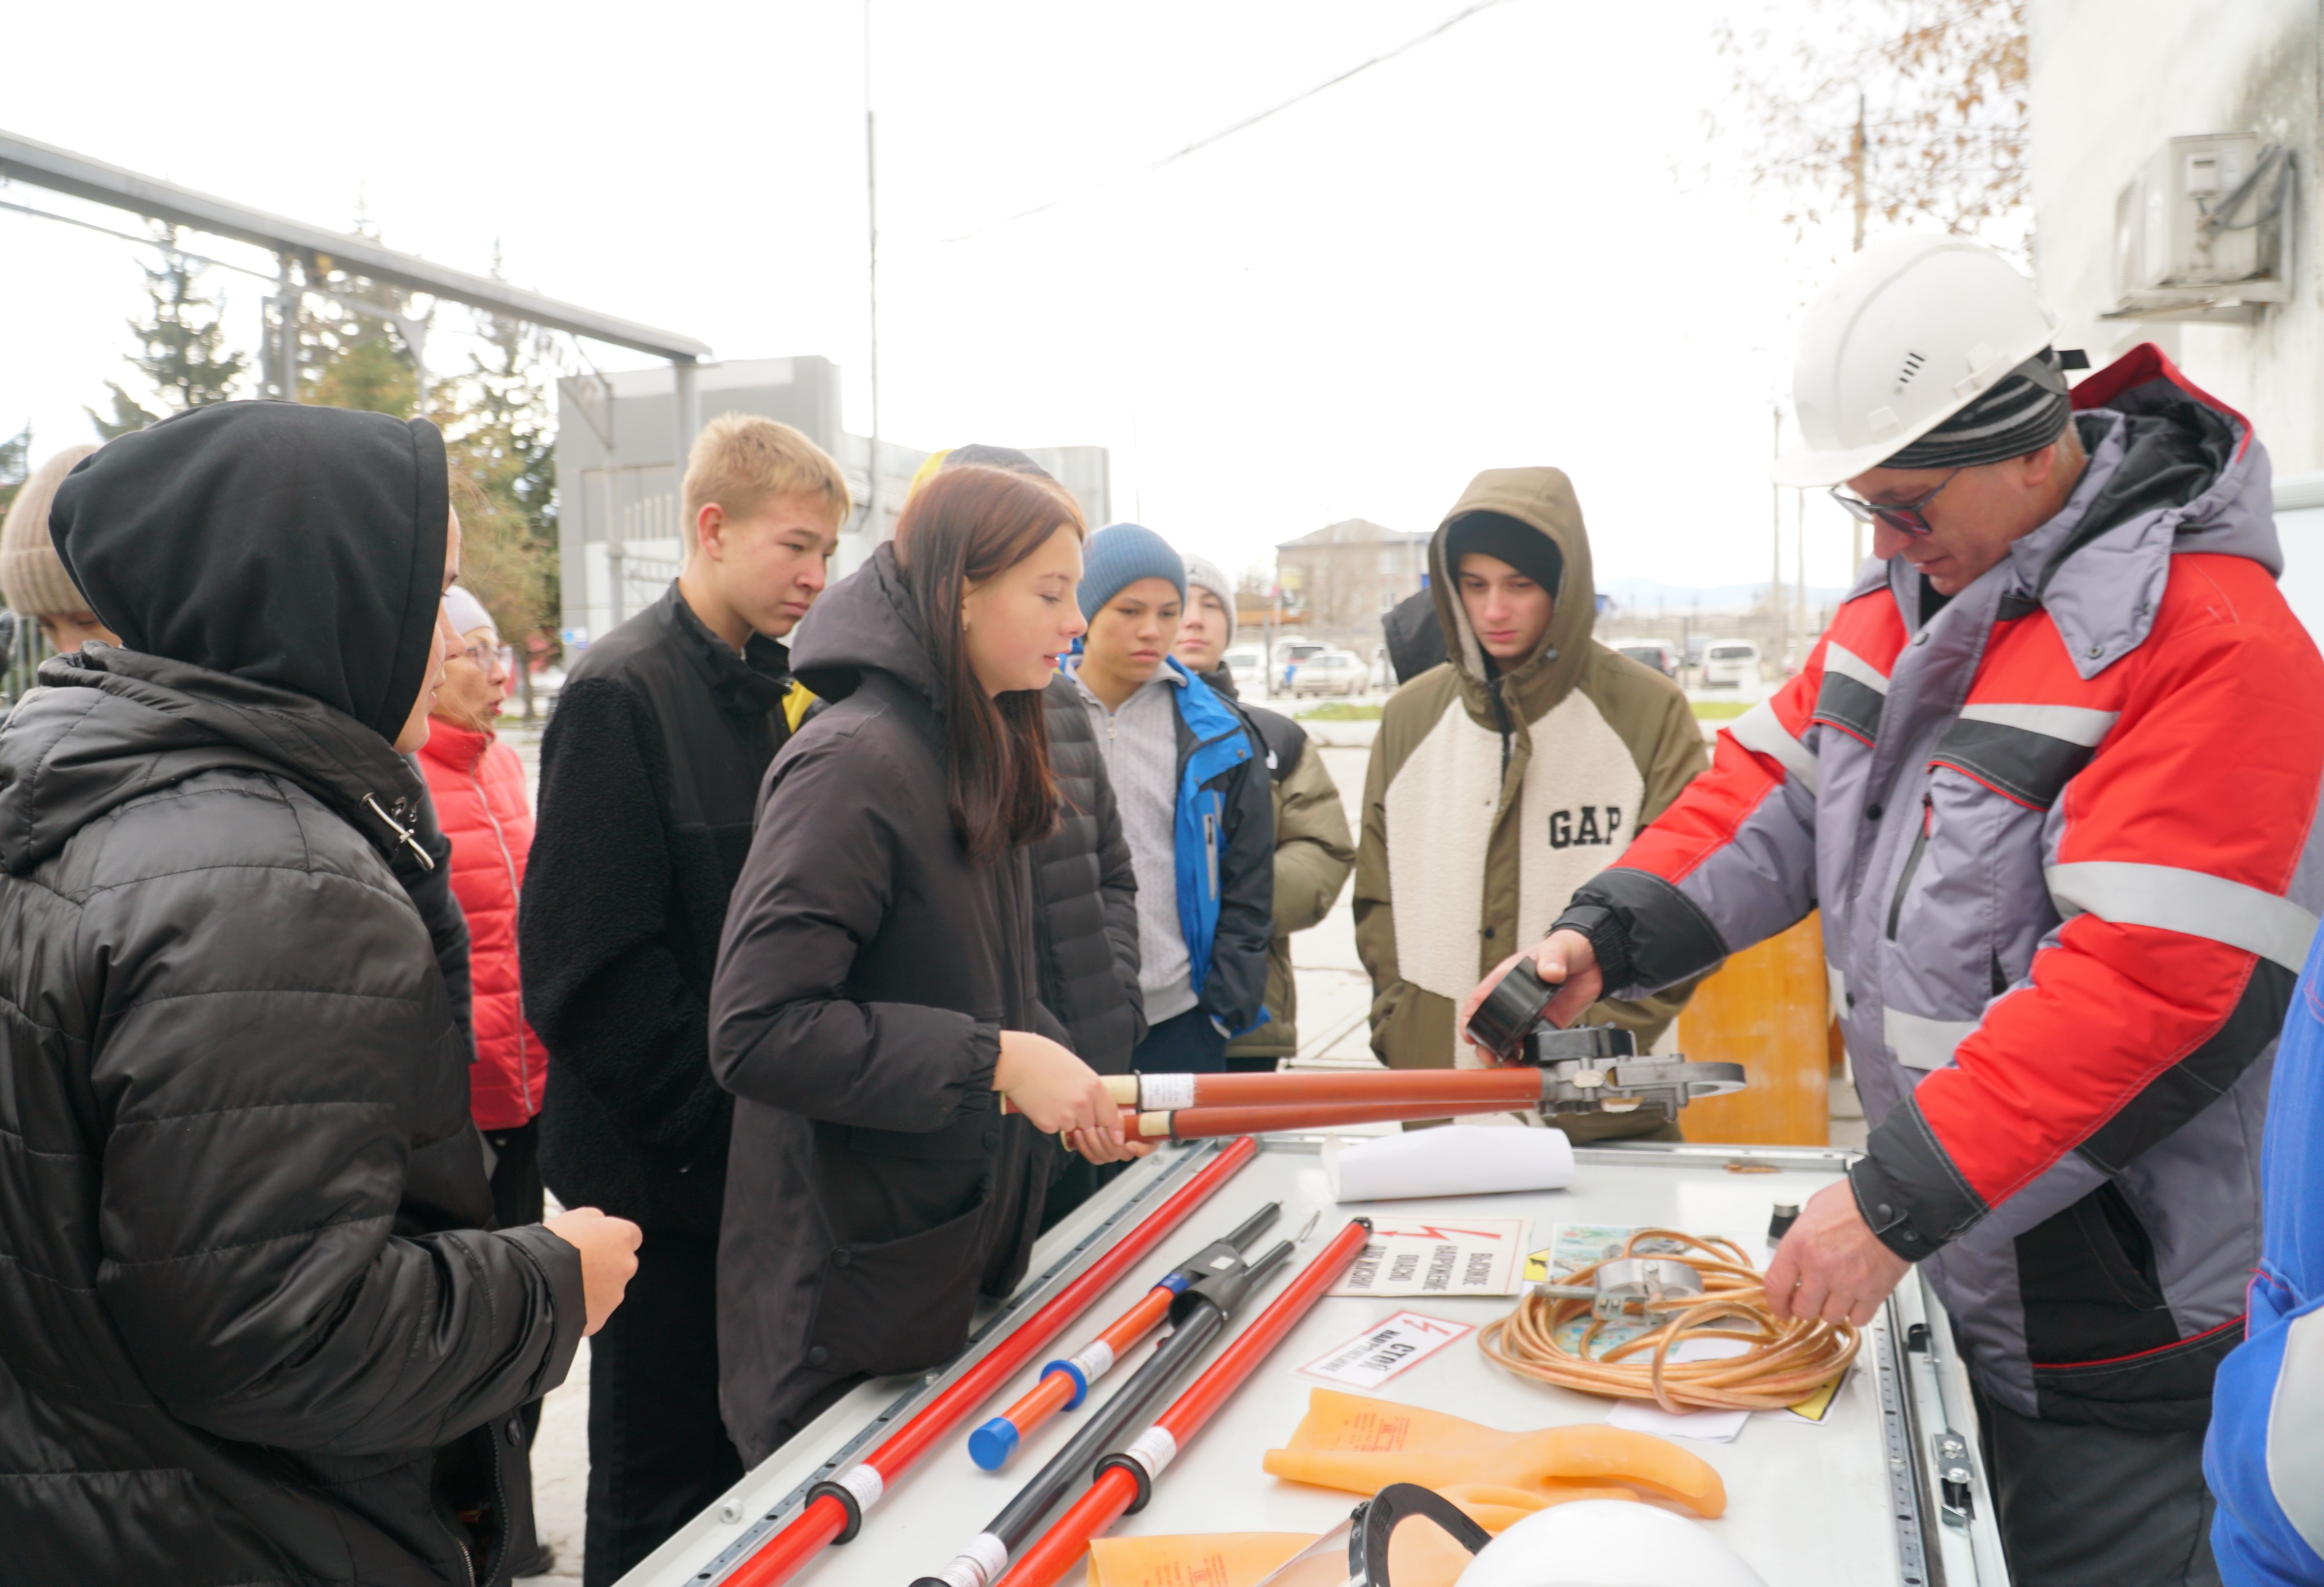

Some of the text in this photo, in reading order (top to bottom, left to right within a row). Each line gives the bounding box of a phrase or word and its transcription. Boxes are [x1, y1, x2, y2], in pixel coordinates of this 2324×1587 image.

[1550, 806, 1622, 850] GAP
[1388, 1254, 1420, 1282] ОПАСНО
[1422, 1245, 1459, 1291] НАПРЯЖЕНИЕ
[1463, 1253, 1493, 1286] ВЫСОКОЕ
[1319, 1329, 1401, 1372] НАПРЯЖЕНИЕ
[1358, 1343, 1416, 1372] СТОЙ
